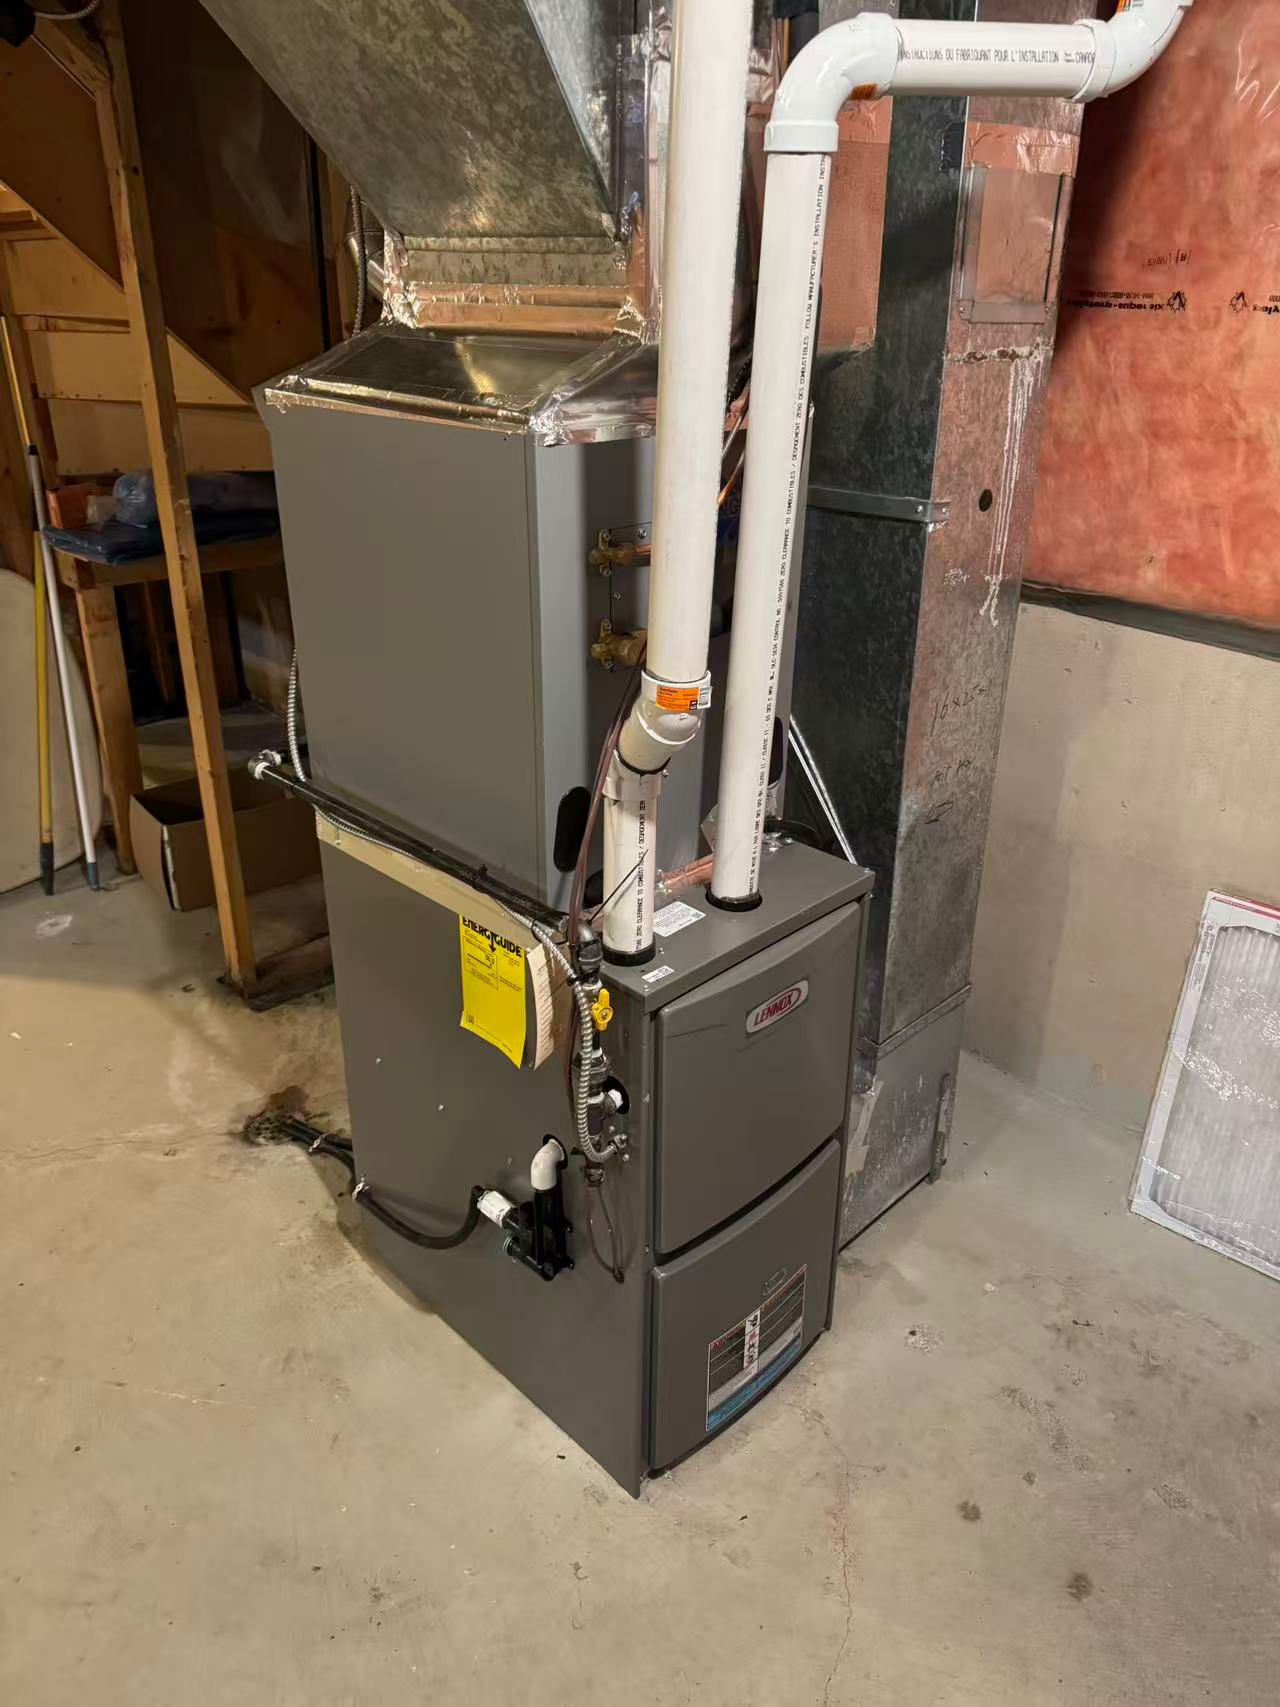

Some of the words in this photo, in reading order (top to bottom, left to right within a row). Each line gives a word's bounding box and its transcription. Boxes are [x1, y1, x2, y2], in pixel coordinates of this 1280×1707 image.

[994, 49, 1008, 62] POUR
[1011, 49, 1059, 63] L'INSTALLATION
[813, 184, 823, 236] INSTALLATION
[806, 241, 820, 300] MANUFACTURER'S
[804, 303, 813, 329] FOLLOW
[800, 335, 809, 384] COMBUSTIBLES
[787, 470, 795, 514] COMBUSTIBLES
[782, 528, 790, 559] CLEARANCE
[753, 992, 794, 1027] LENNOX
